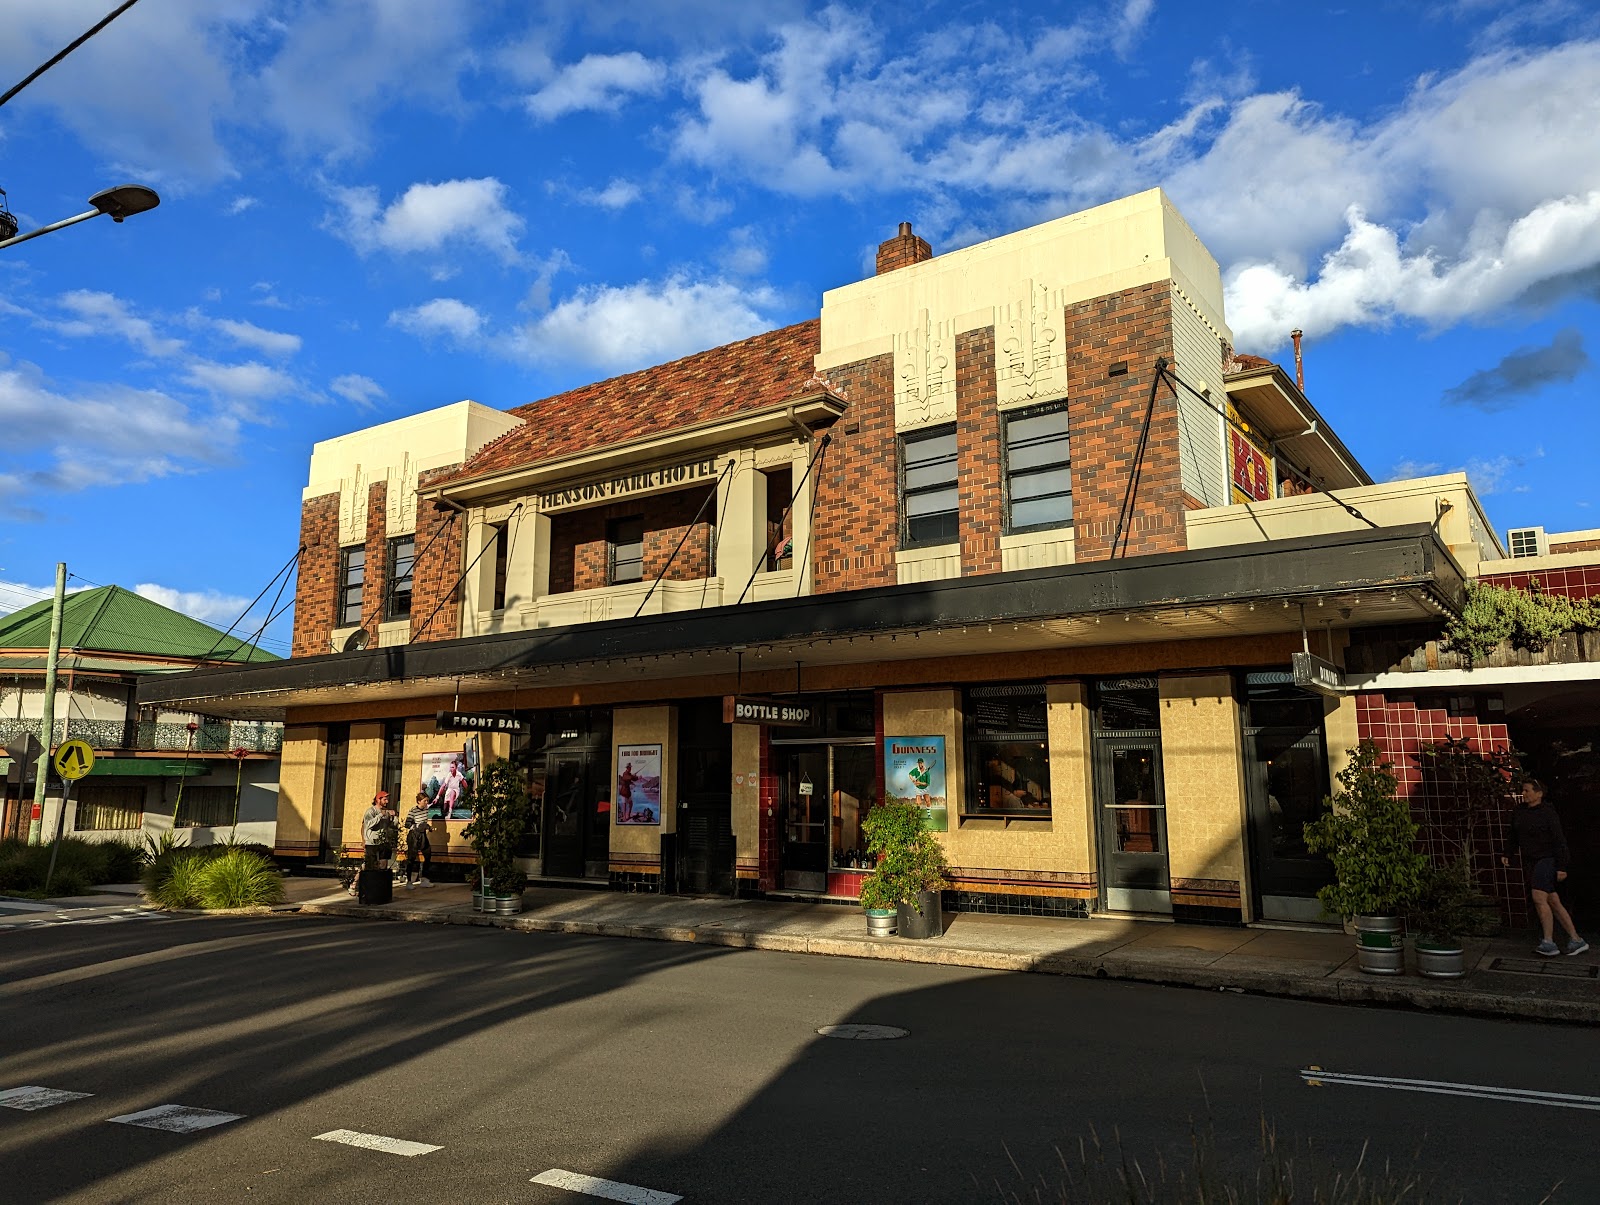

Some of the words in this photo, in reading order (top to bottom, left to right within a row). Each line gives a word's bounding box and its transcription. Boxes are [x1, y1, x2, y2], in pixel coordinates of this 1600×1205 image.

[541, 482, 606, 508] HENSON
[610, 472, 654, 495] PARK
[660, 459, 717, 486] HOTEL
[1319, 665, 1339, 686] DINING
[736, 703, 779, 721] BOTTLE
[781, 706, 811, 722] SHOP
[452, 716, 494, 728] FRONT
[497, 719, 521, 730] BAR
[892, 743, 937, 755] GUINNESS
